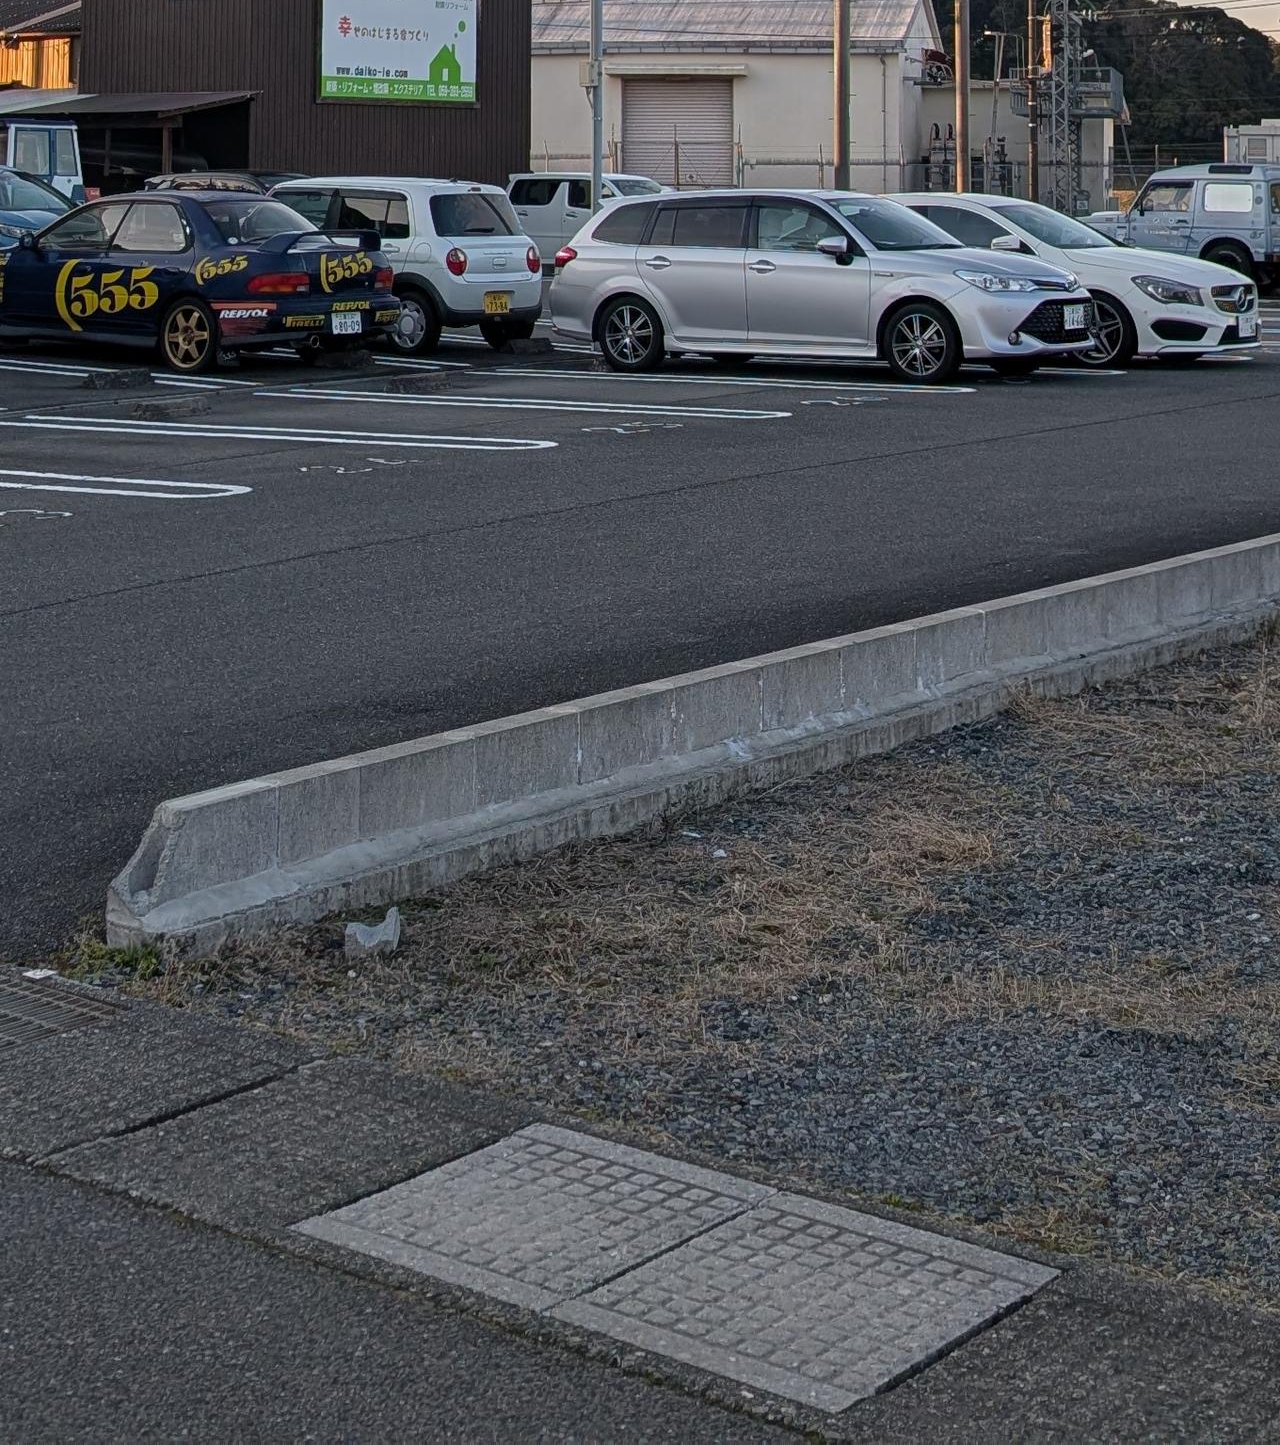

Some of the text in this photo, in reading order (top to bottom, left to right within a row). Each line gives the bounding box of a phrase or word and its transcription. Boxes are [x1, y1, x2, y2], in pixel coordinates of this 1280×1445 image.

[331, 301, 370, 312] REPSOL
[219, 308, 271, 319] REPSOL
[282, 314, 326, 328] PIRELLI
